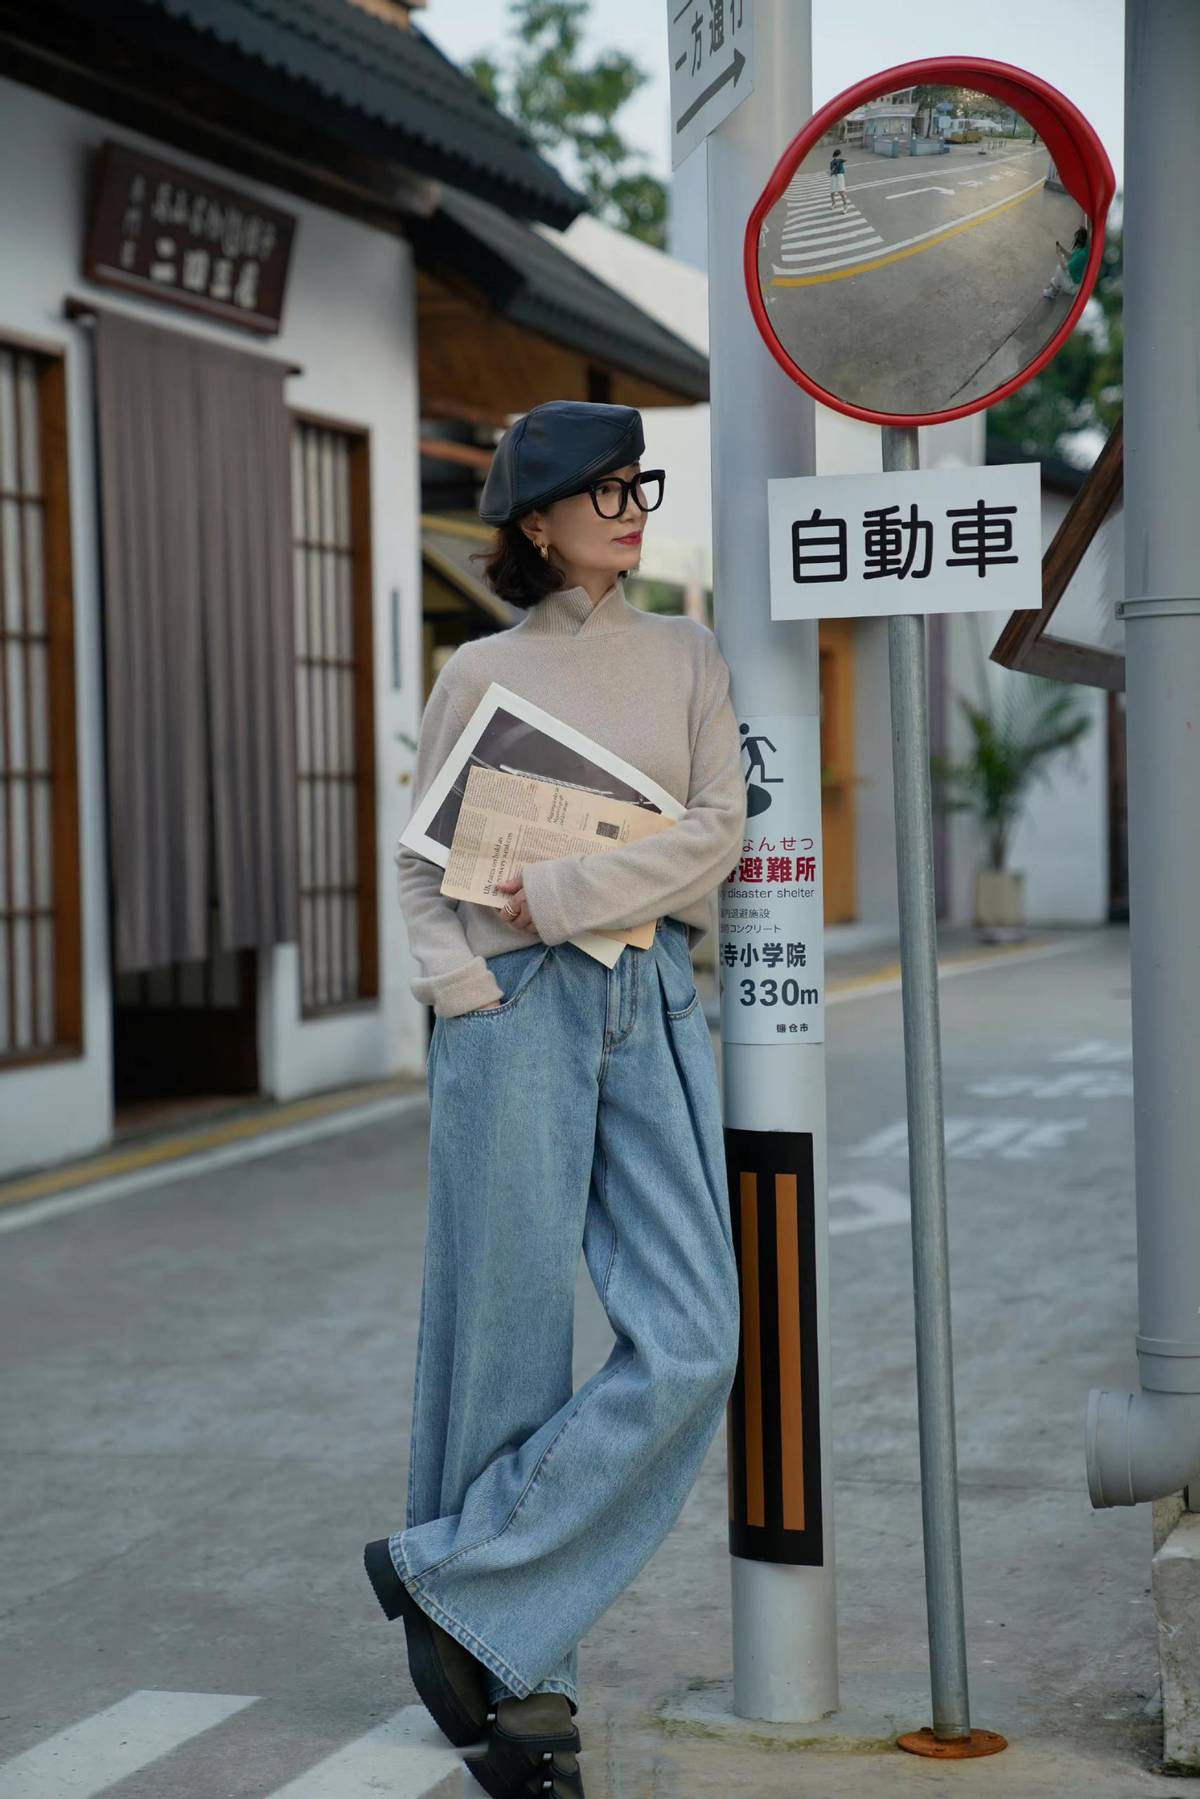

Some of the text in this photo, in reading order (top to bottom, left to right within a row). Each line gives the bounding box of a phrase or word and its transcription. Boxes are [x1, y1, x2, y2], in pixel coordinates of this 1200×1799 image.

[792, 499, 1018, 583] 自動車
[728, 888, 773, 899] disaster
[777, 888, 815, 898] shelter
[721, 942, 806, 968] 寺小学院
[740, 978, 818, 1007] 330m
